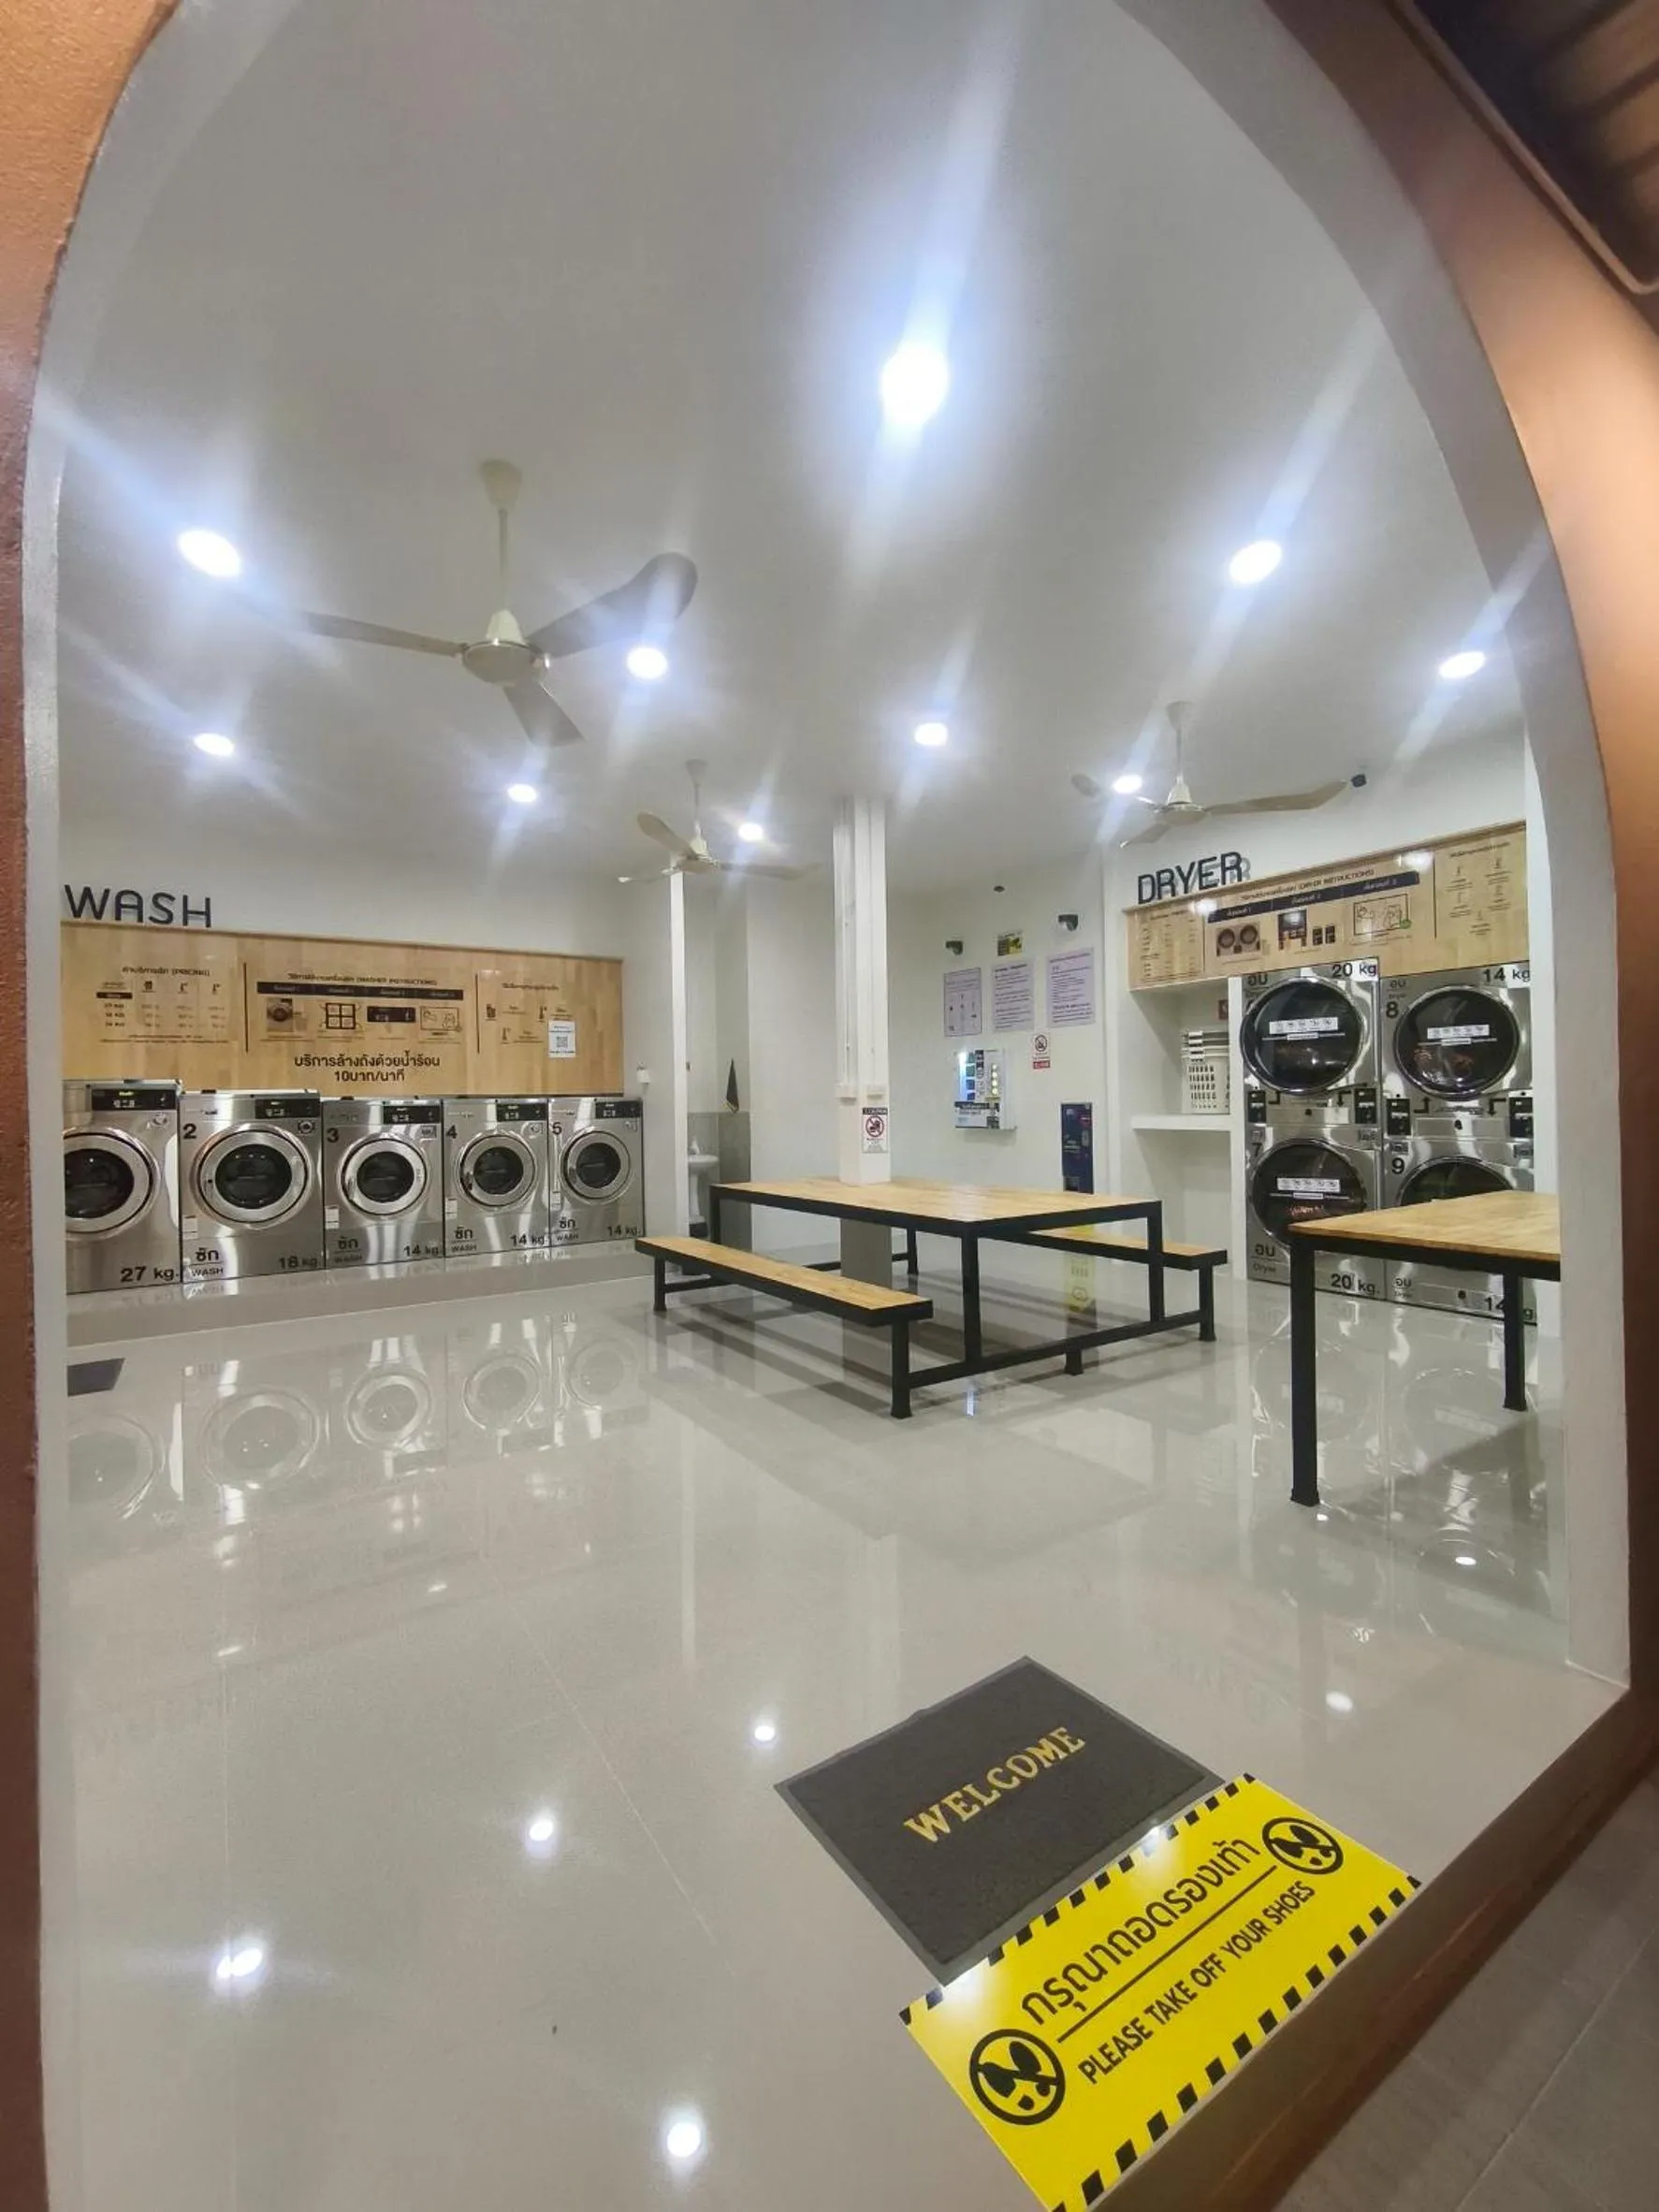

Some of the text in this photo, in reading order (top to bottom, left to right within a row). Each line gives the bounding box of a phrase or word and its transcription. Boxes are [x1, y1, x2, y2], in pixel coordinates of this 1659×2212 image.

[1138, 851, 1243, 904] DRYER
[65, 884, 211, 928] WASH
[1332, 962, 1377, 978] 20 kg
[1482, 967, 1506, 982] 14
[1386, 1001, 1399, 1018] 8
[182, 1123, 196, 1139] 2
[327, 1127, 339, 1142] 3
[446, 1125, 458, 1139] 4
[552, 1122, 561, 1135] 5
[1253, 1142, 1262, 1157] 7
[1392, 1157, 1404, 1174] 9
[454, 1226, 473, 1240] ซัก
[607, 1224, 621, 1236] 14
[510, 1233, 528, 1246] 14
[196, 1247, 219, 1262] ซัก
[403, 1244, 421, 1256] 14
[1255, 1243, 1275, 1257] อบ
[280, 1256, 298, 1269] 18
[120, 1266, 146, 1282] 27
[191, 1268, 224, 1277] WASH
[1331, 1273, 1352, 1289] 20
[903, 1726, 1086, 1842] WELCOME
[1022, 1839, 1260, 2025] กรุณาถอดรองเท้า
[1078, 1880, 1316, 2085] PLEASE TAKE OFF YOUR SHOES
